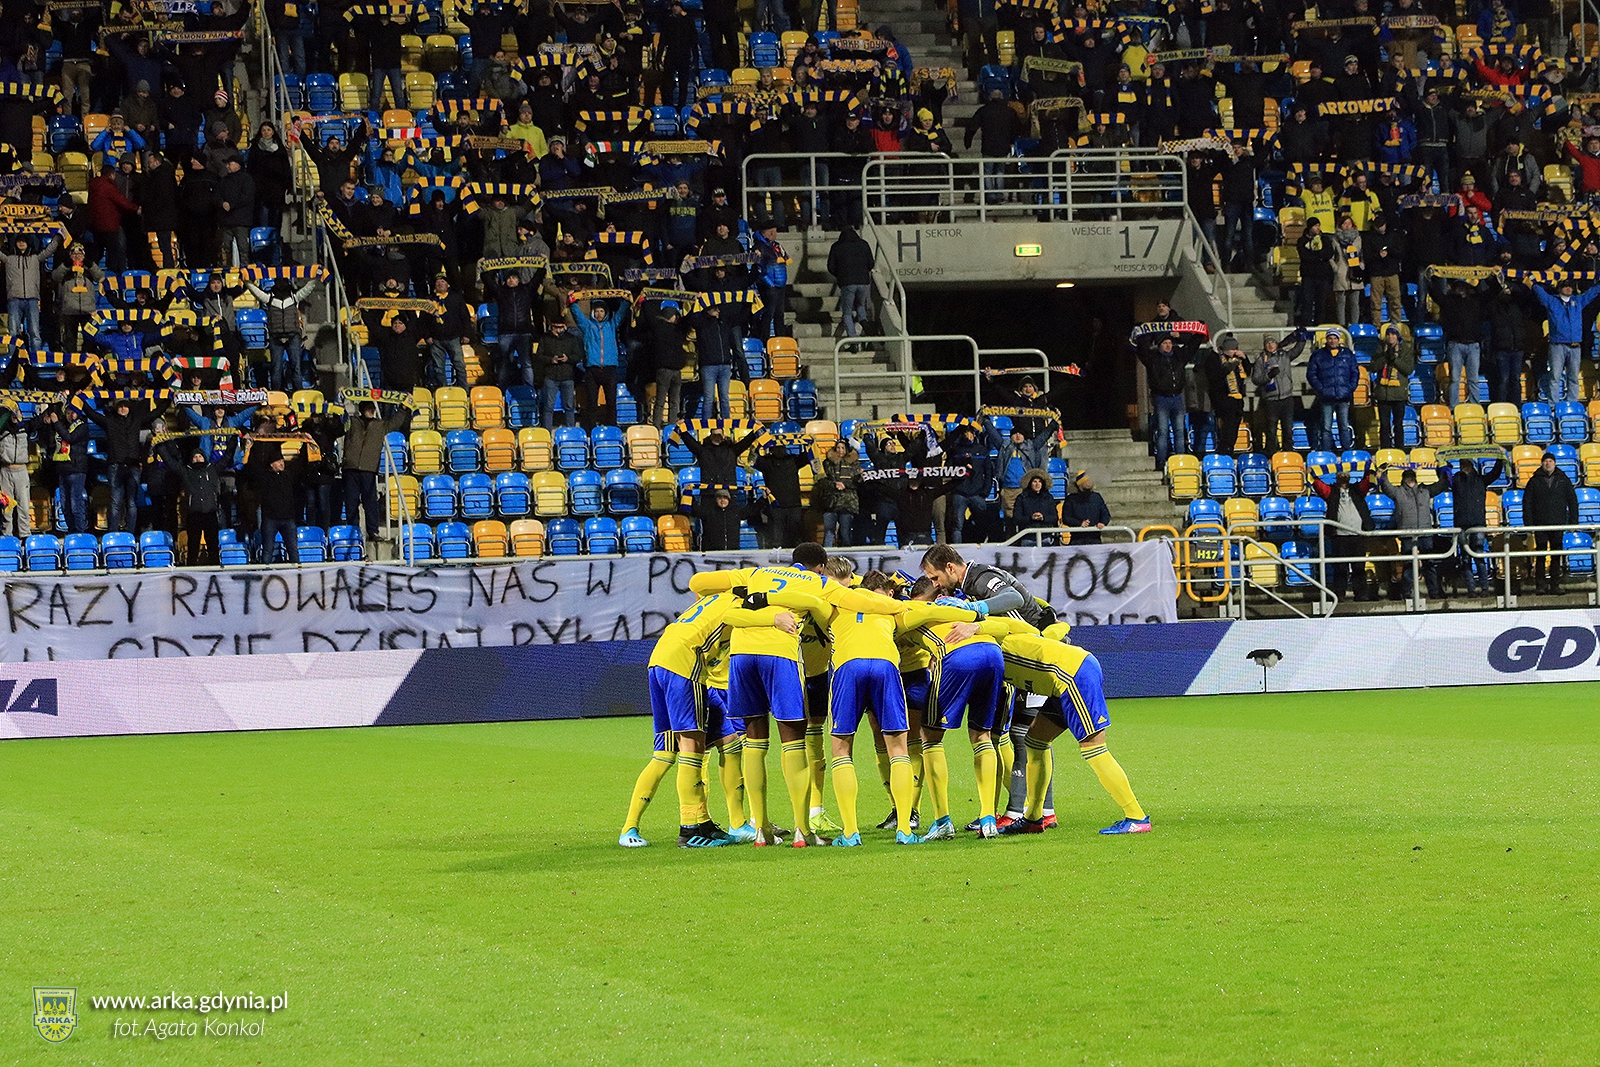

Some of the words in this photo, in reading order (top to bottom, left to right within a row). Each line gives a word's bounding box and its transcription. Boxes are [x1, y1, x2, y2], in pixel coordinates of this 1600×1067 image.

[1317, 97, 1395, 117] ARKOWCY
[925, 229, 963, 238] SEKTOR
[1071, 225, 1113, 237] WEJŚCIE
[897, 229, 921, 262] H
[1118, 225, 1160, 260] 17
[568, 262, 610, 275] GDYNIA
[1113, 264, 1146, 273] MIEJSCA
[1142, 321, 1173, 333] ARKA
[982, 406, 1017, 416] ARKA
[862, 468, 900, 482] BRATE
[923, 466, 967, 478] RSTWO
[1197, 550, 1218, 560] H17
[3, 581, 143, 633] RAZY
[469, 560, 559, 608] NAS
[586, 562, 614, 597] W
[1487, 625, 1600, 674] GD
